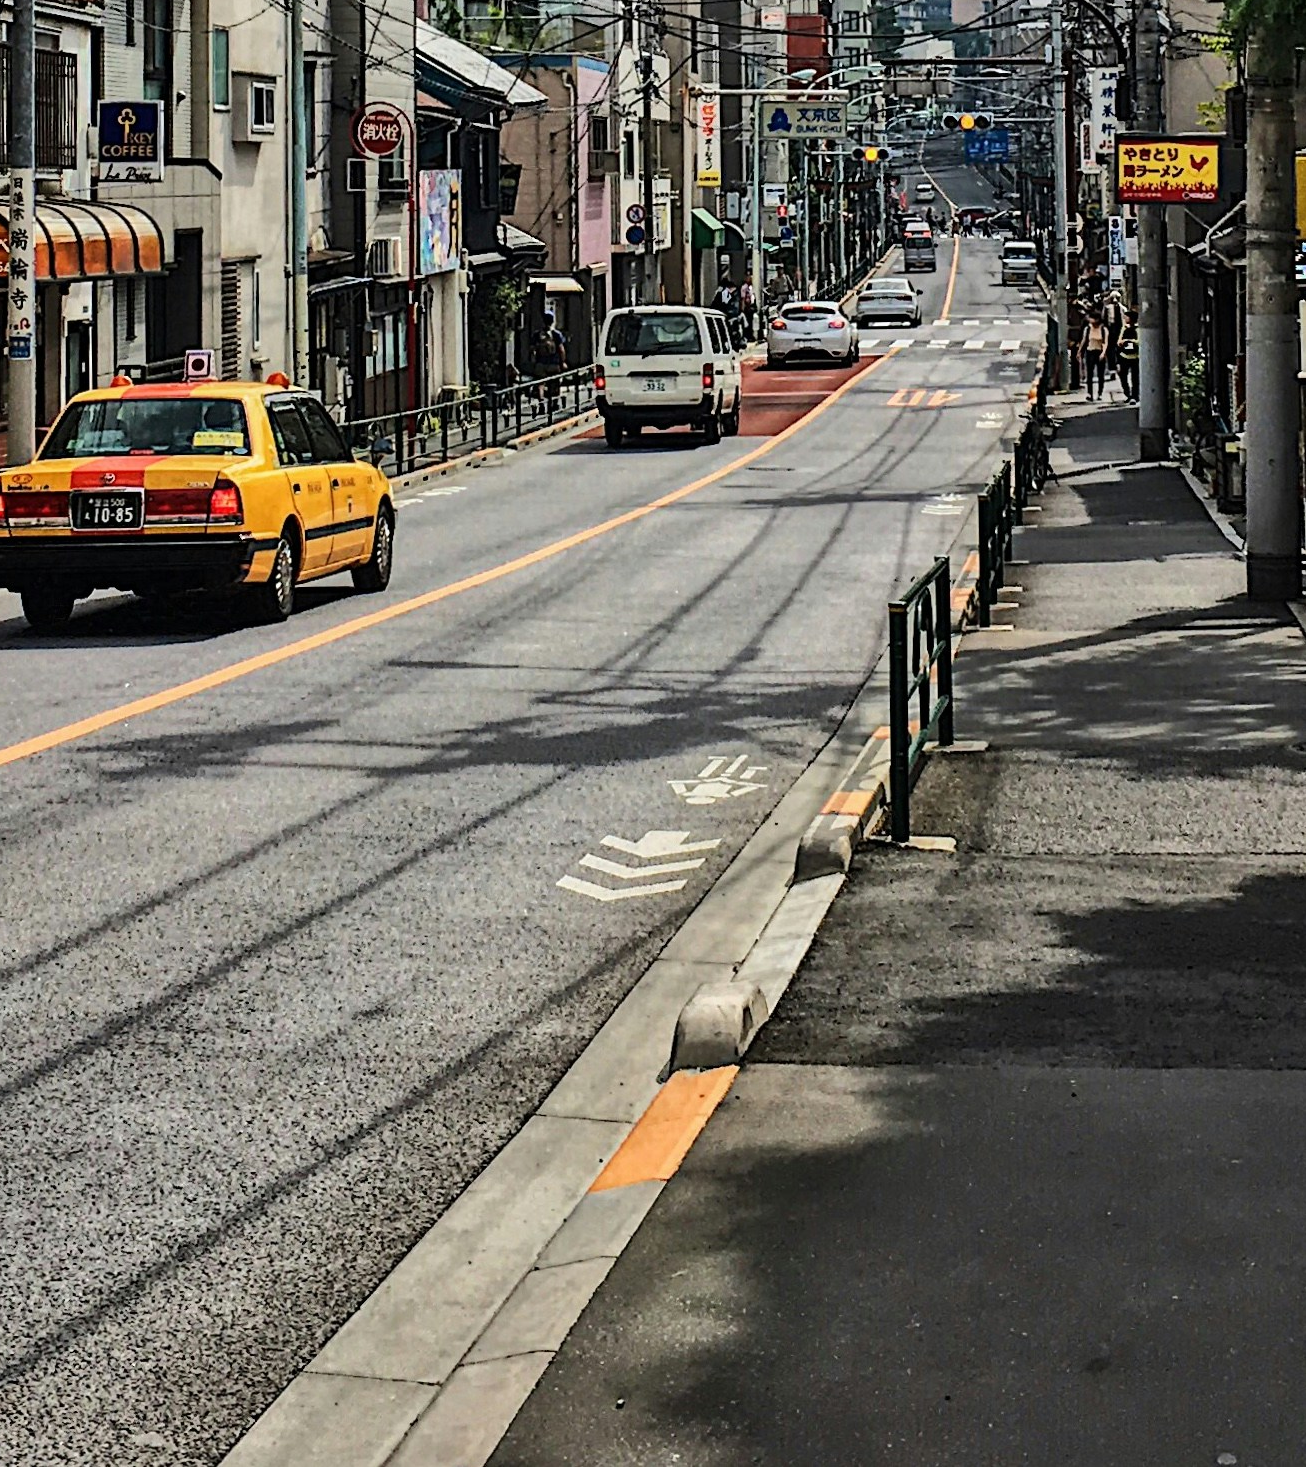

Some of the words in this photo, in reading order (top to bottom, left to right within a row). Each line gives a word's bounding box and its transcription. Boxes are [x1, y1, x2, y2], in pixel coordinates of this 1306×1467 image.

[797, 108, 842, 123] 文京区
[130, 132, 155, 144] KEY
[362, 123, 399, 141] 消火栓
[102, 145, 154, 157] COFFEE
[1123, 147, 1179, 162] やきとり
[94, 507, 134, 523] 10-85
